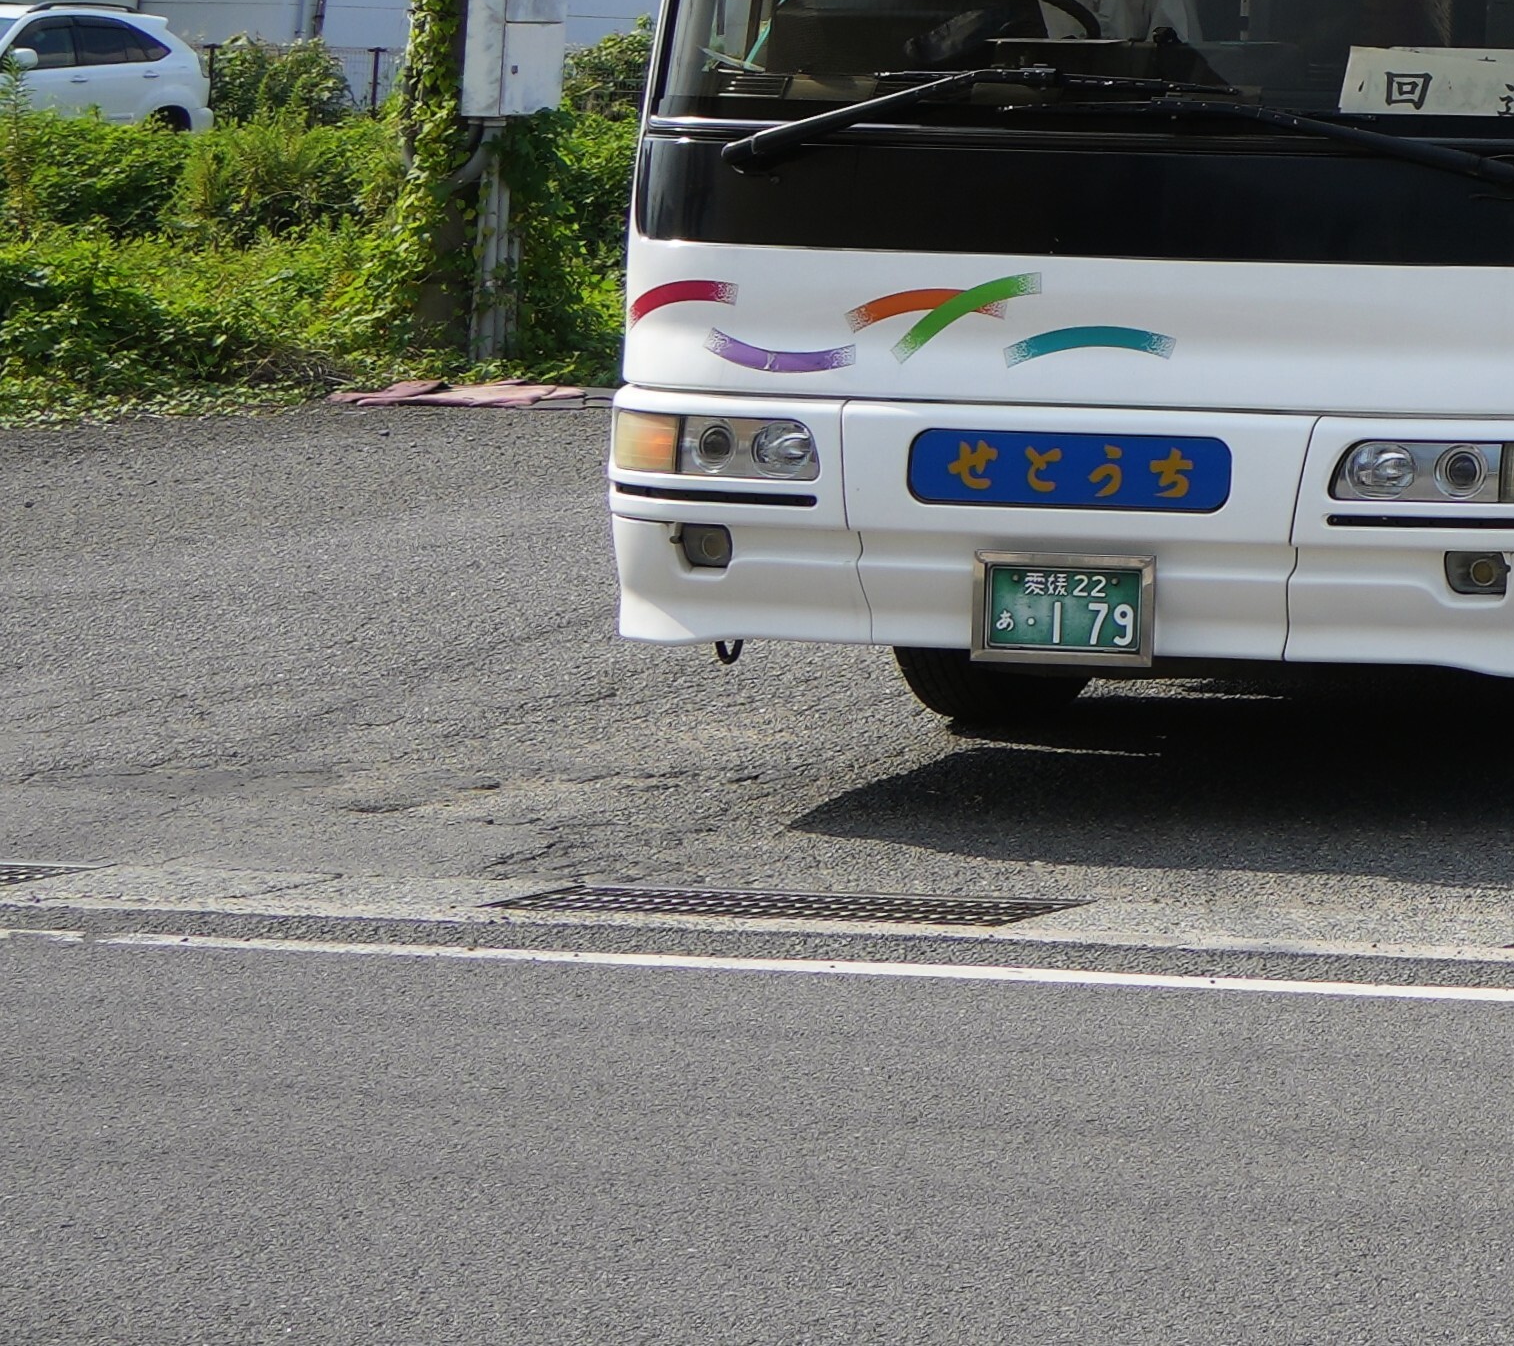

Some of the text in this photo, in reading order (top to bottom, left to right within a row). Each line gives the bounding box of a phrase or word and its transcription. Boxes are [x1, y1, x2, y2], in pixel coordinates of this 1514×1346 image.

[947, 439, 1194, 498] せとうち
[1024, 572, 1107, 597] 愛媛 22
[996, 609, 1015, 631] あ
